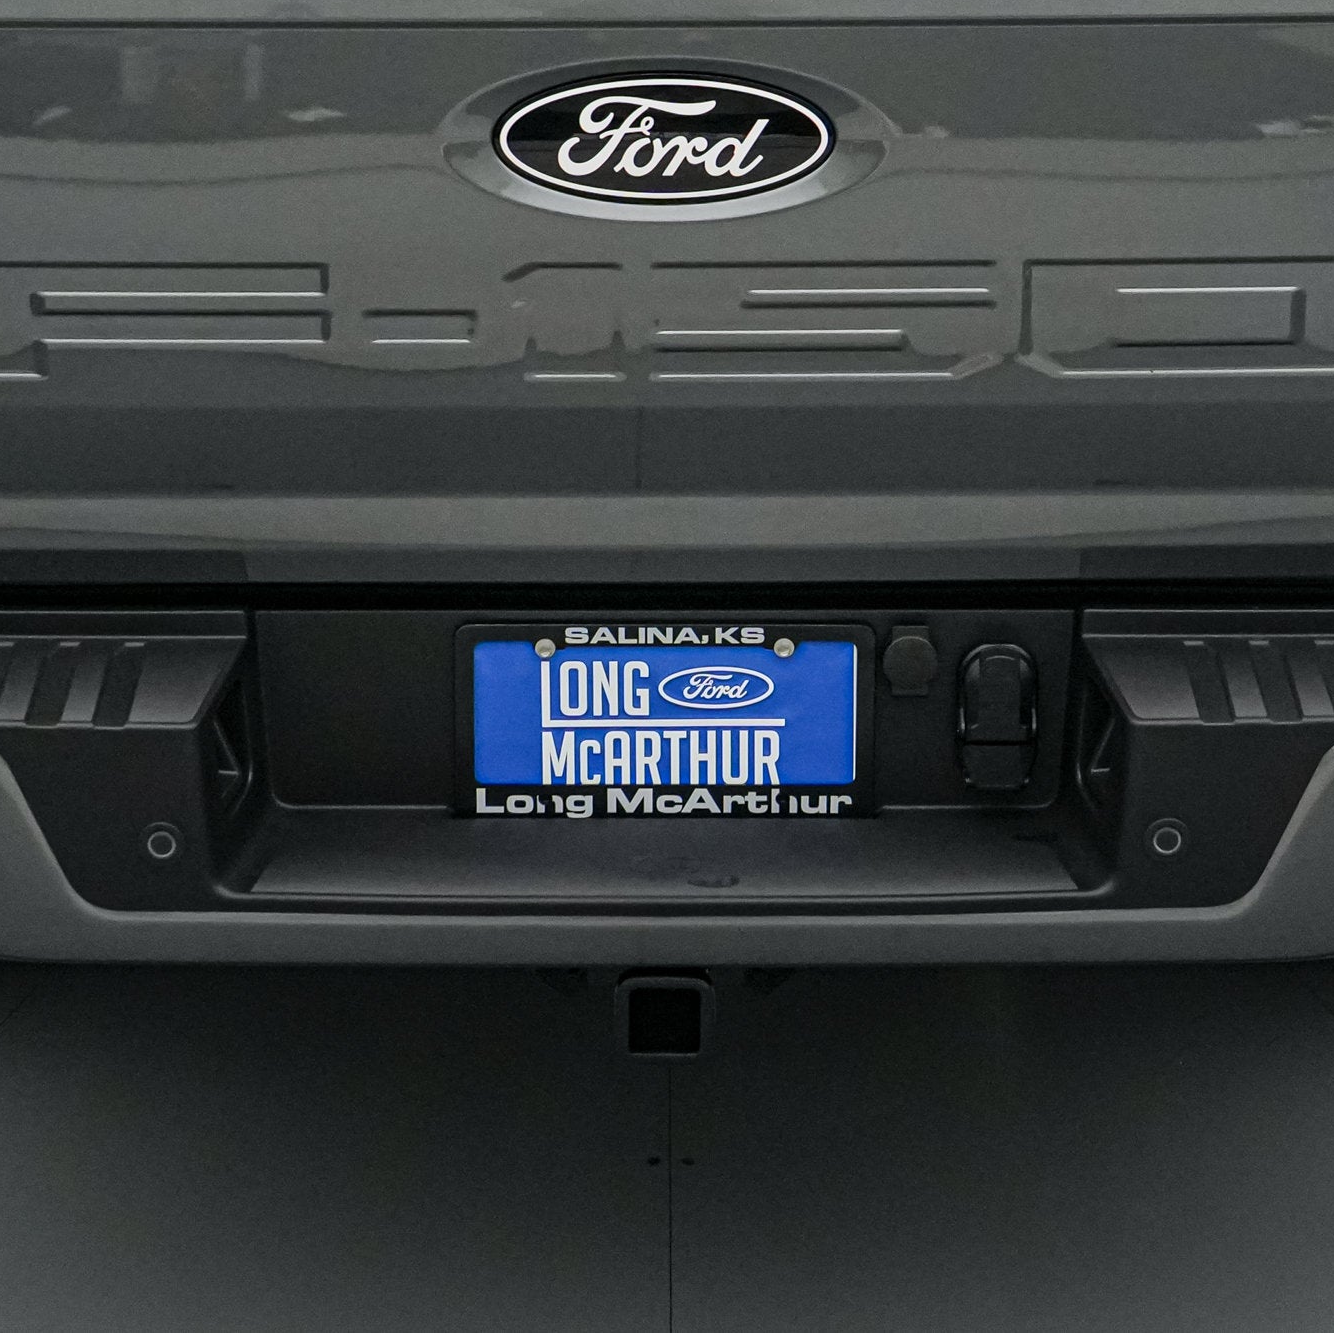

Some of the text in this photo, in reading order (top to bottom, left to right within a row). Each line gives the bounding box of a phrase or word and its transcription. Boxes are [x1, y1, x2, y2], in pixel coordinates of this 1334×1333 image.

[556, 95, 770, 180] Ford
[564, 626, 765, 645] SALINA, KS
[541, 660, 748, 726] LONG Ford
[542, 731, 781, 785] McARTHUR
[475, 788, 852, 818] Long McArthur
